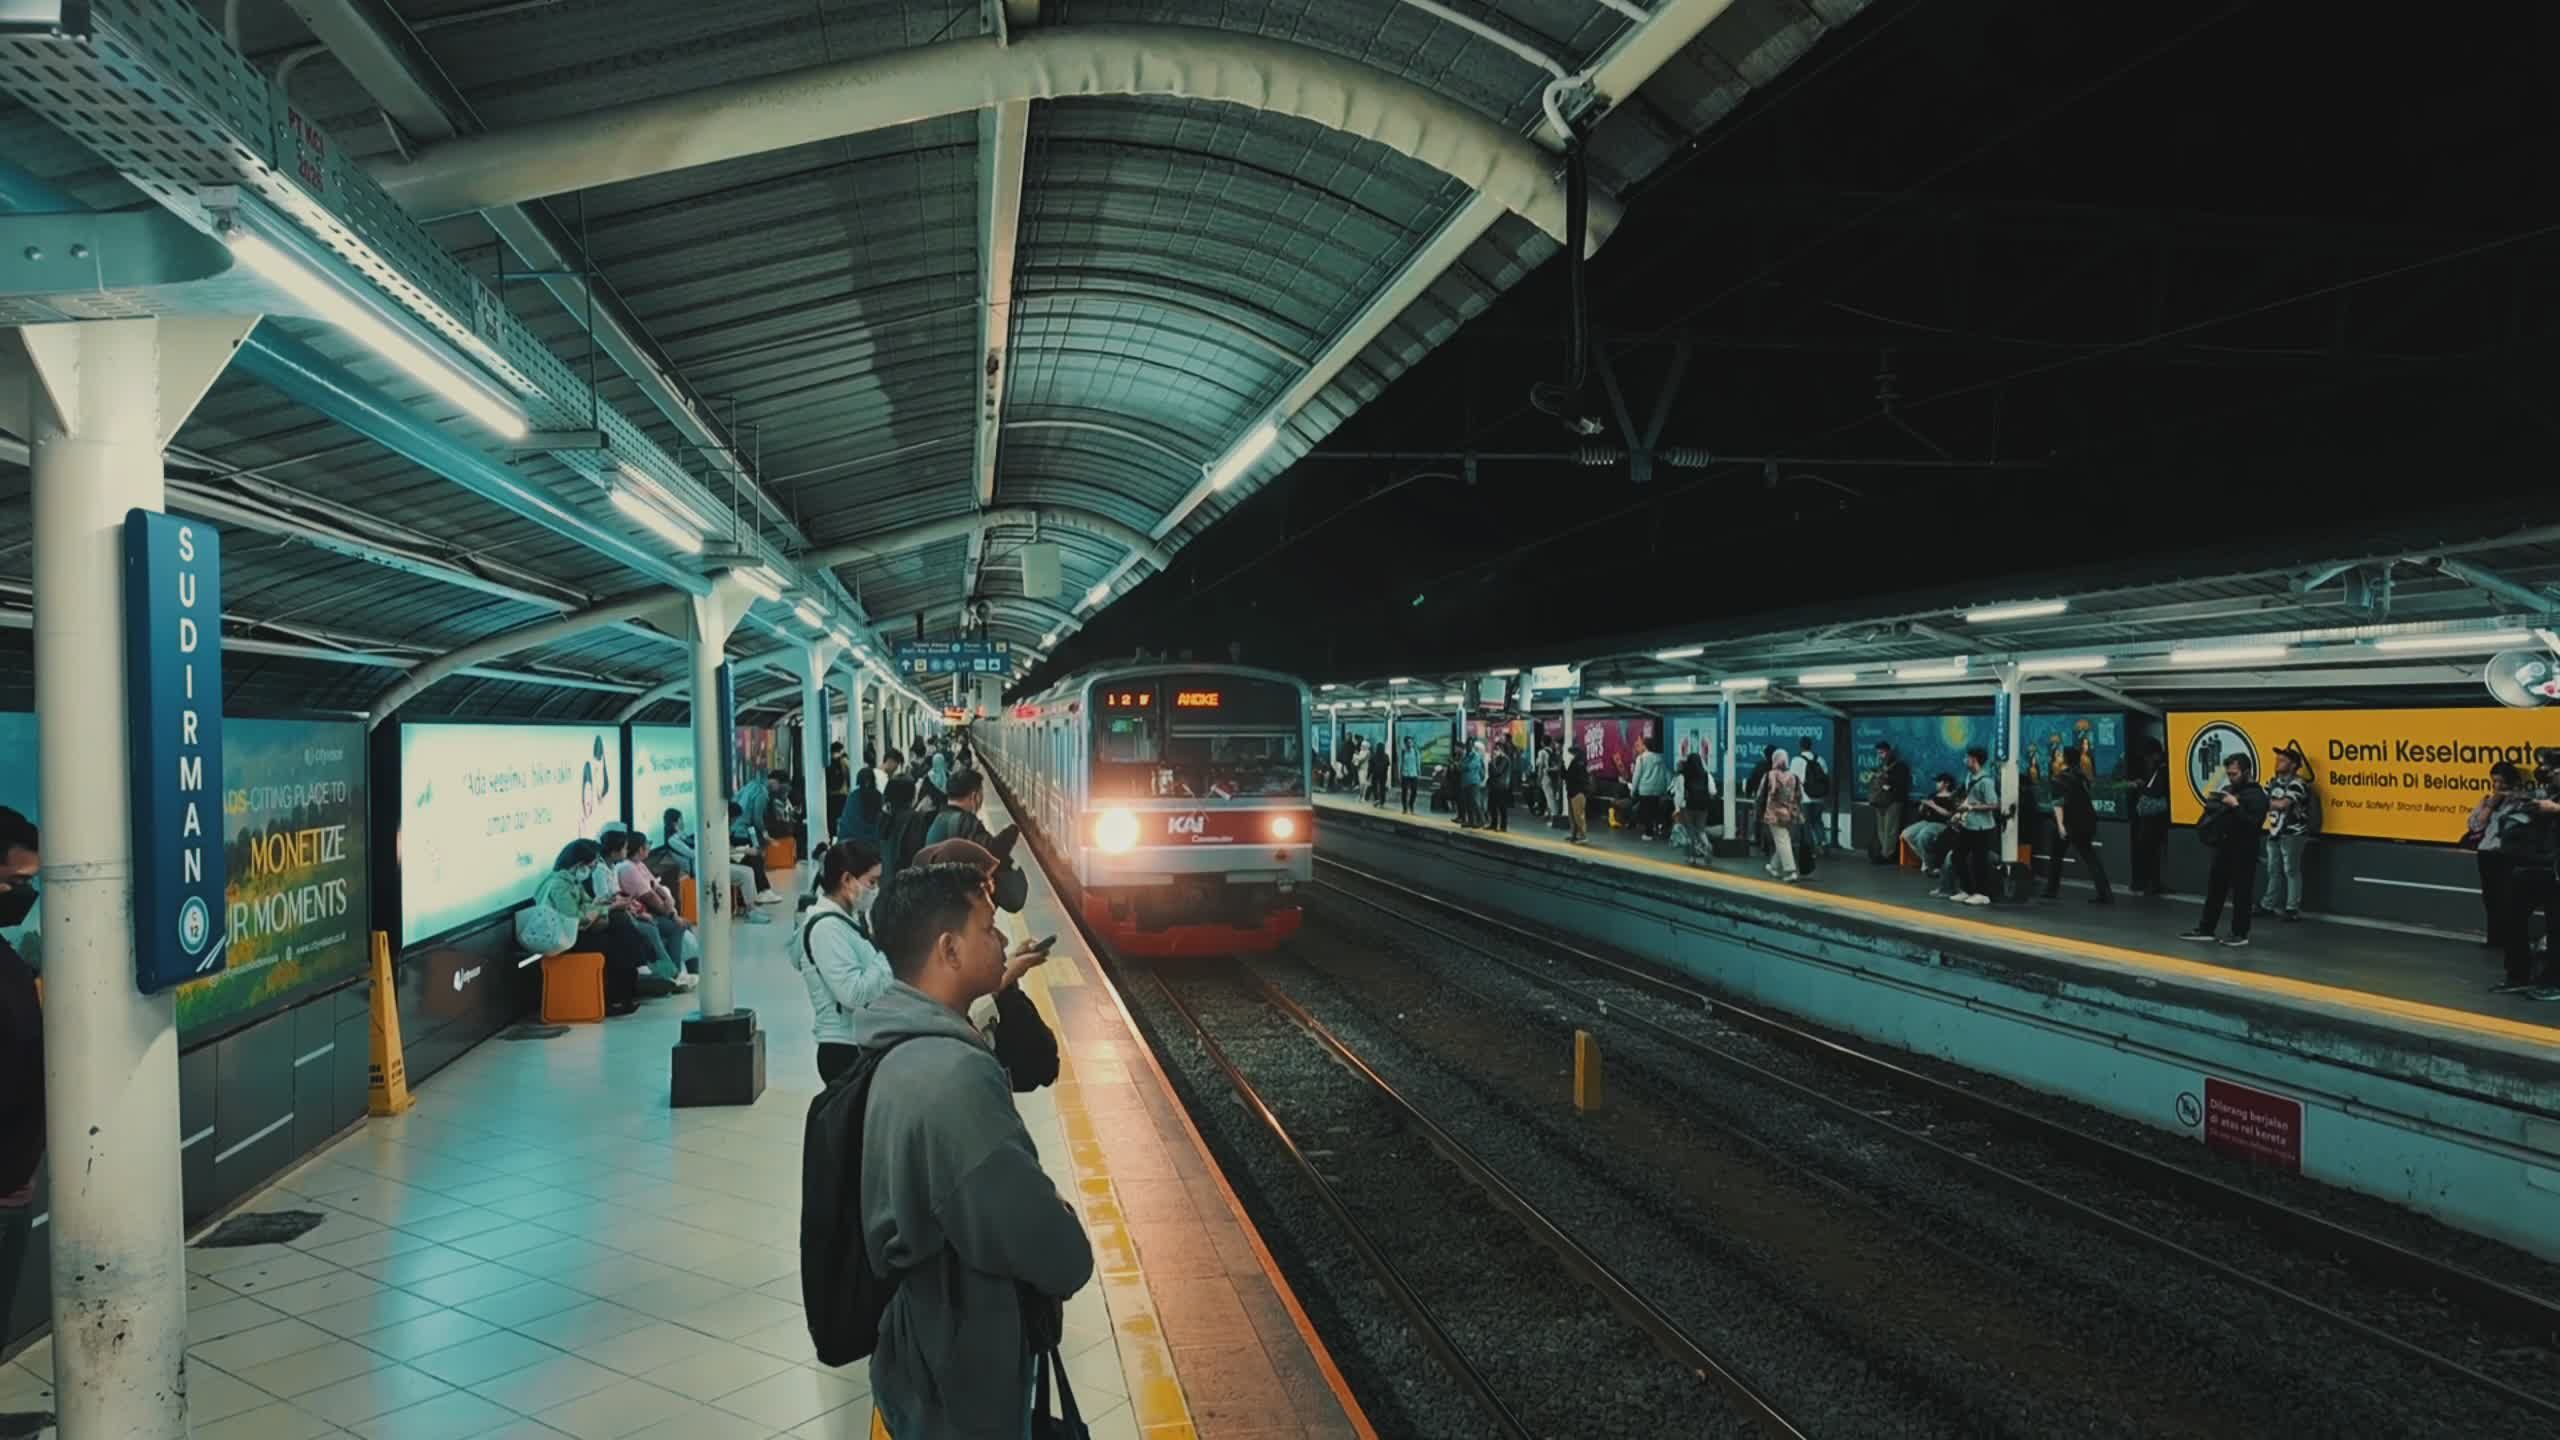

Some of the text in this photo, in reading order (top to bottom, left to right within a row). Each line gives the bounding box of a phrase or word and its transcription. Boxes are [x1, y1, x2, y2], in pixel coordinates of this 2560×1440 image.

[178, 526, 202, 884] SUDIRMAN
[2328, 739, 2388, 761] Demi
[330, 780, 346, 803] TO
[2330, 771, 2398, 787] Berdirilah
[2403, 773, 2419, 788] Di
[2424, 774, 2497, 791] Belakan
[1168, 815, 1204, 832] KAI
[251, 824, 347, 879] MONETIZE
[254, 878, 347, 937] MOMENTS
